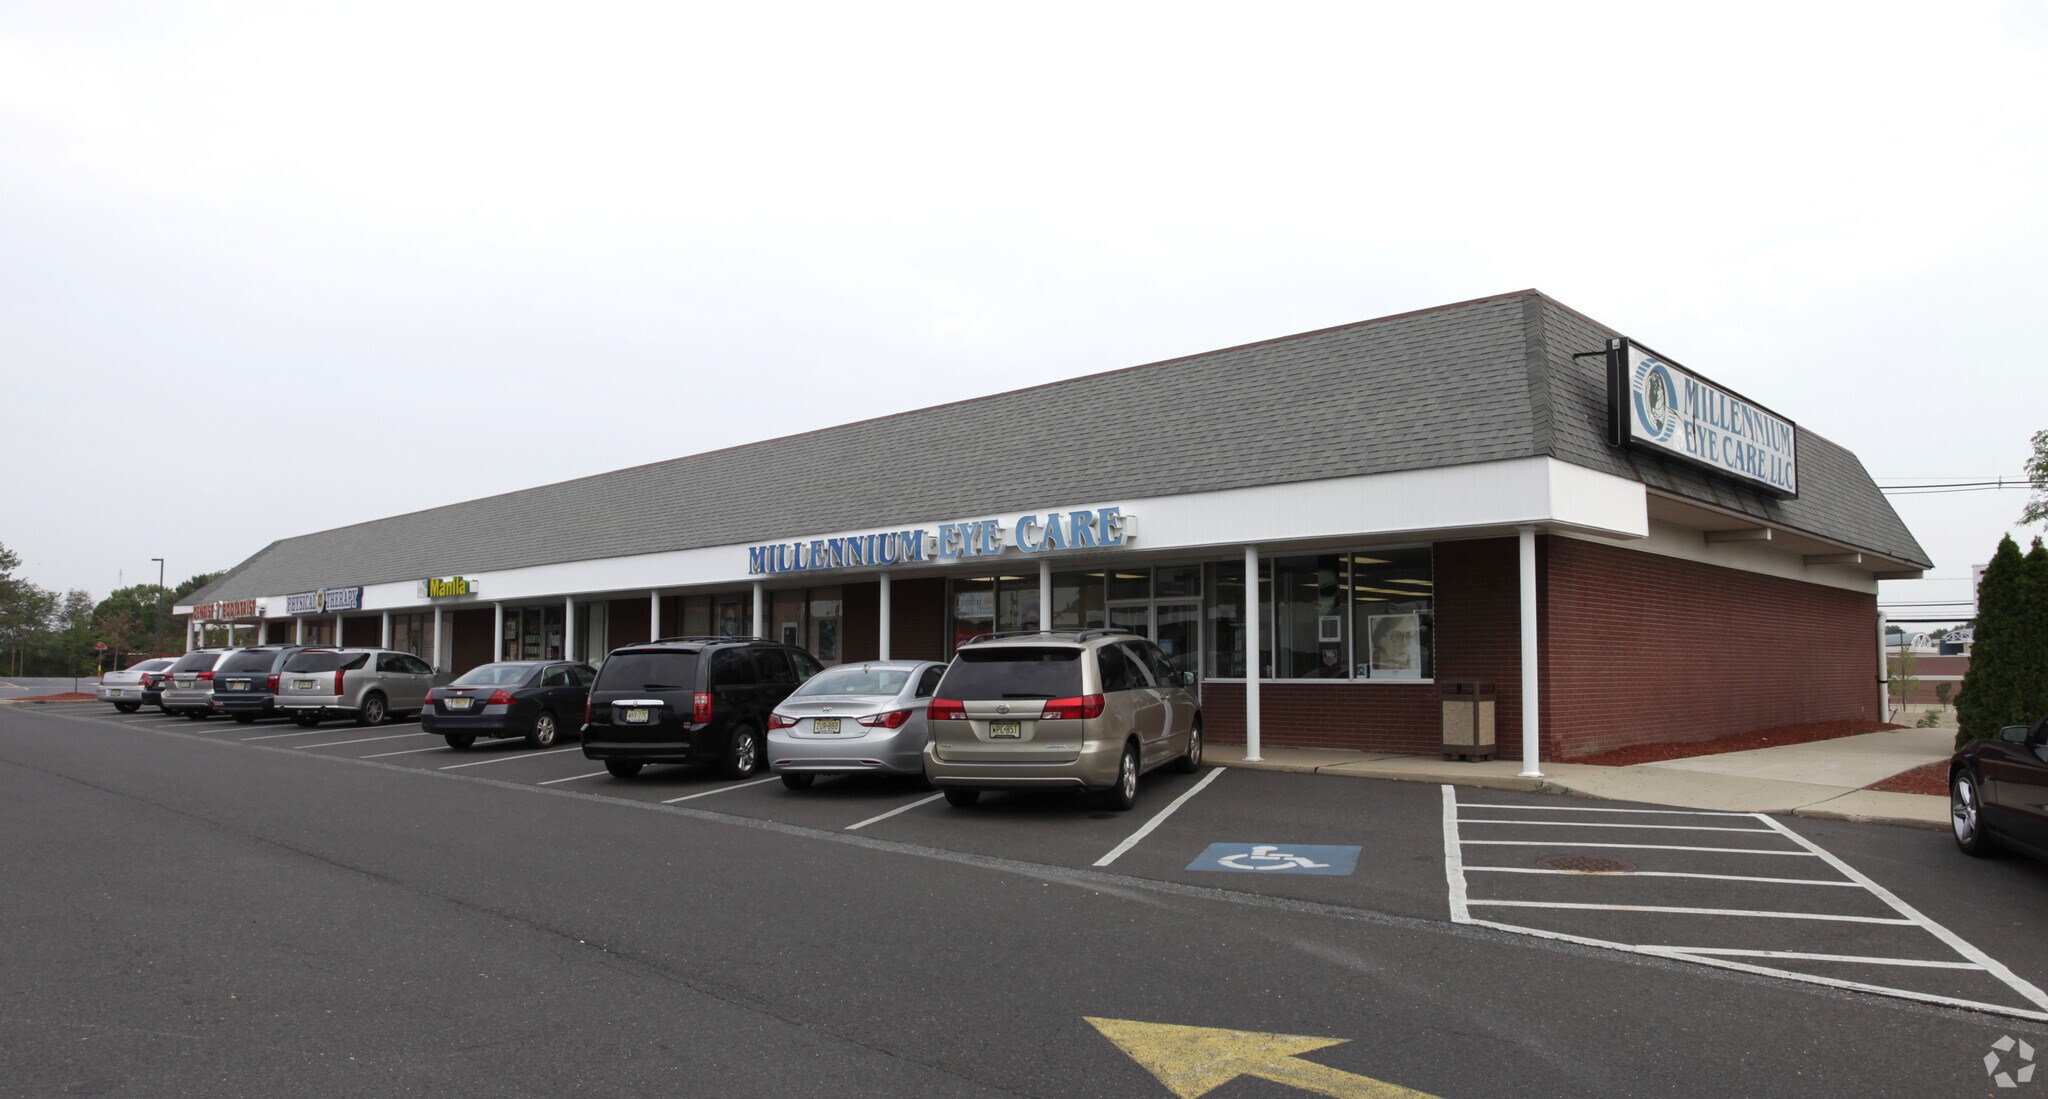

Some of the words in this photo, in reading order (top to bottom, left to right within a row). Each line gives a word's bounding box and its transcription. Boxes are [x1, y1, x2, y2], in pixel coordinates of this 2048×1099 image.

[1684, 377, 1791, 457] MILLENNIUM
[1683, 420, 1719, 463] EYE
[1771, 454, 1794, 490] LLC
[748, 529, 925, 575] MILLENNIUM
[938, 519, 1004, 559] EYE
[1016, 506, 1125, 553] CARE
[287, 592, 317, 612] PHYSICAL
[325, 588, 358, 610] THERAPY
[429, 576, 466, 597] Manila
